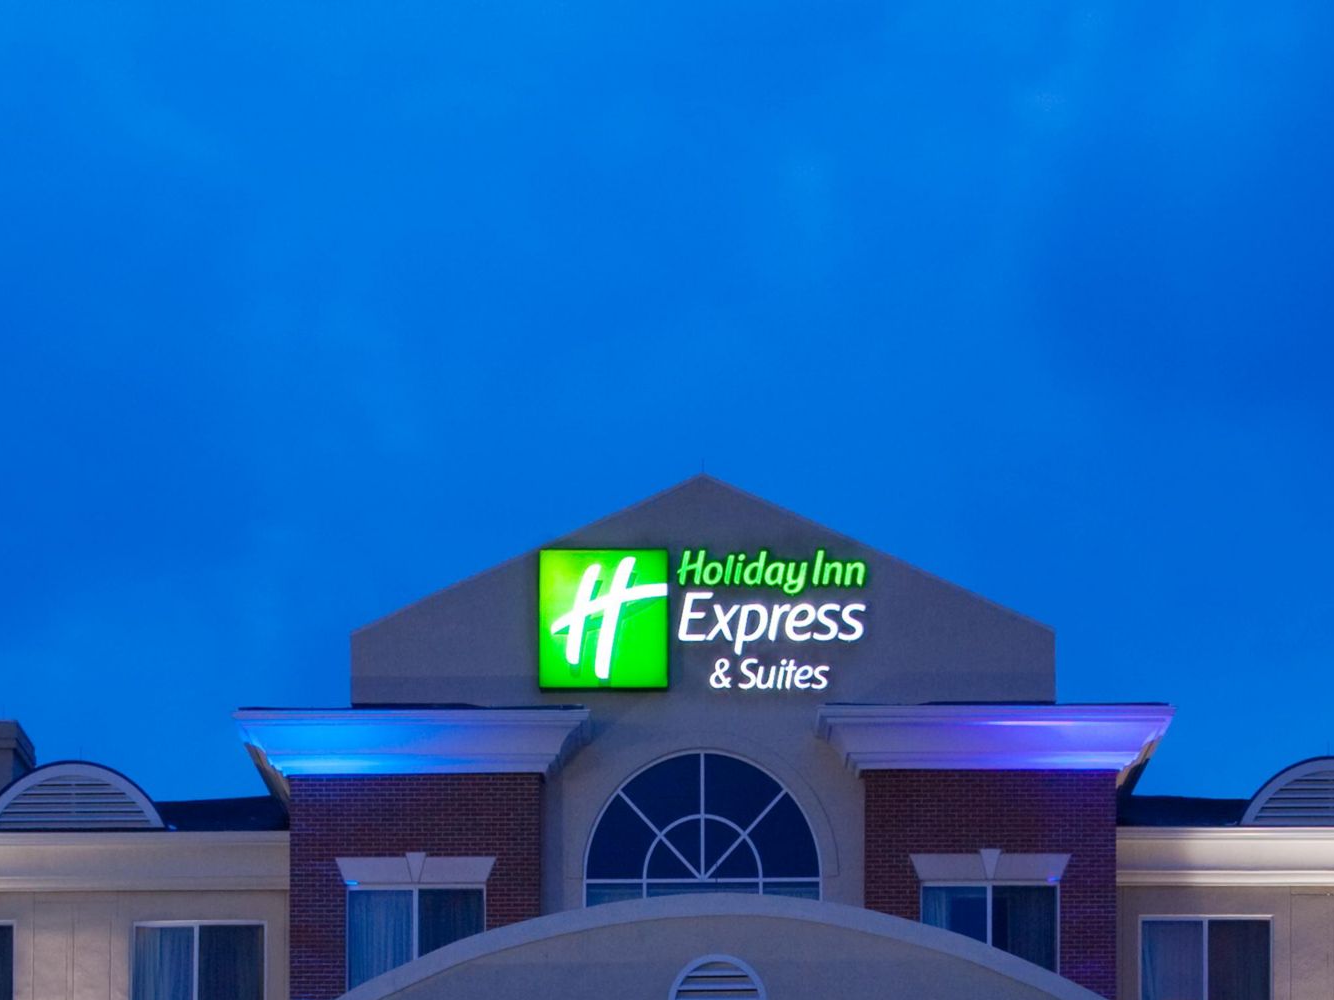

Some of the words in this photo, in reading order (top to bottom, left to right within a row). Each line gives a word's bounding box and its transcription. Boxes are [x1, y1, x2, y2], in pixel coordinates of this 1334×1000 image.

[677, 549, 807, 594] Holiday
[811, 549, 866, 586] Inn
[677, 591, 866, 655] Express
[709, 658, 732, 689] &
[738, 658, 830, 689] Suites
